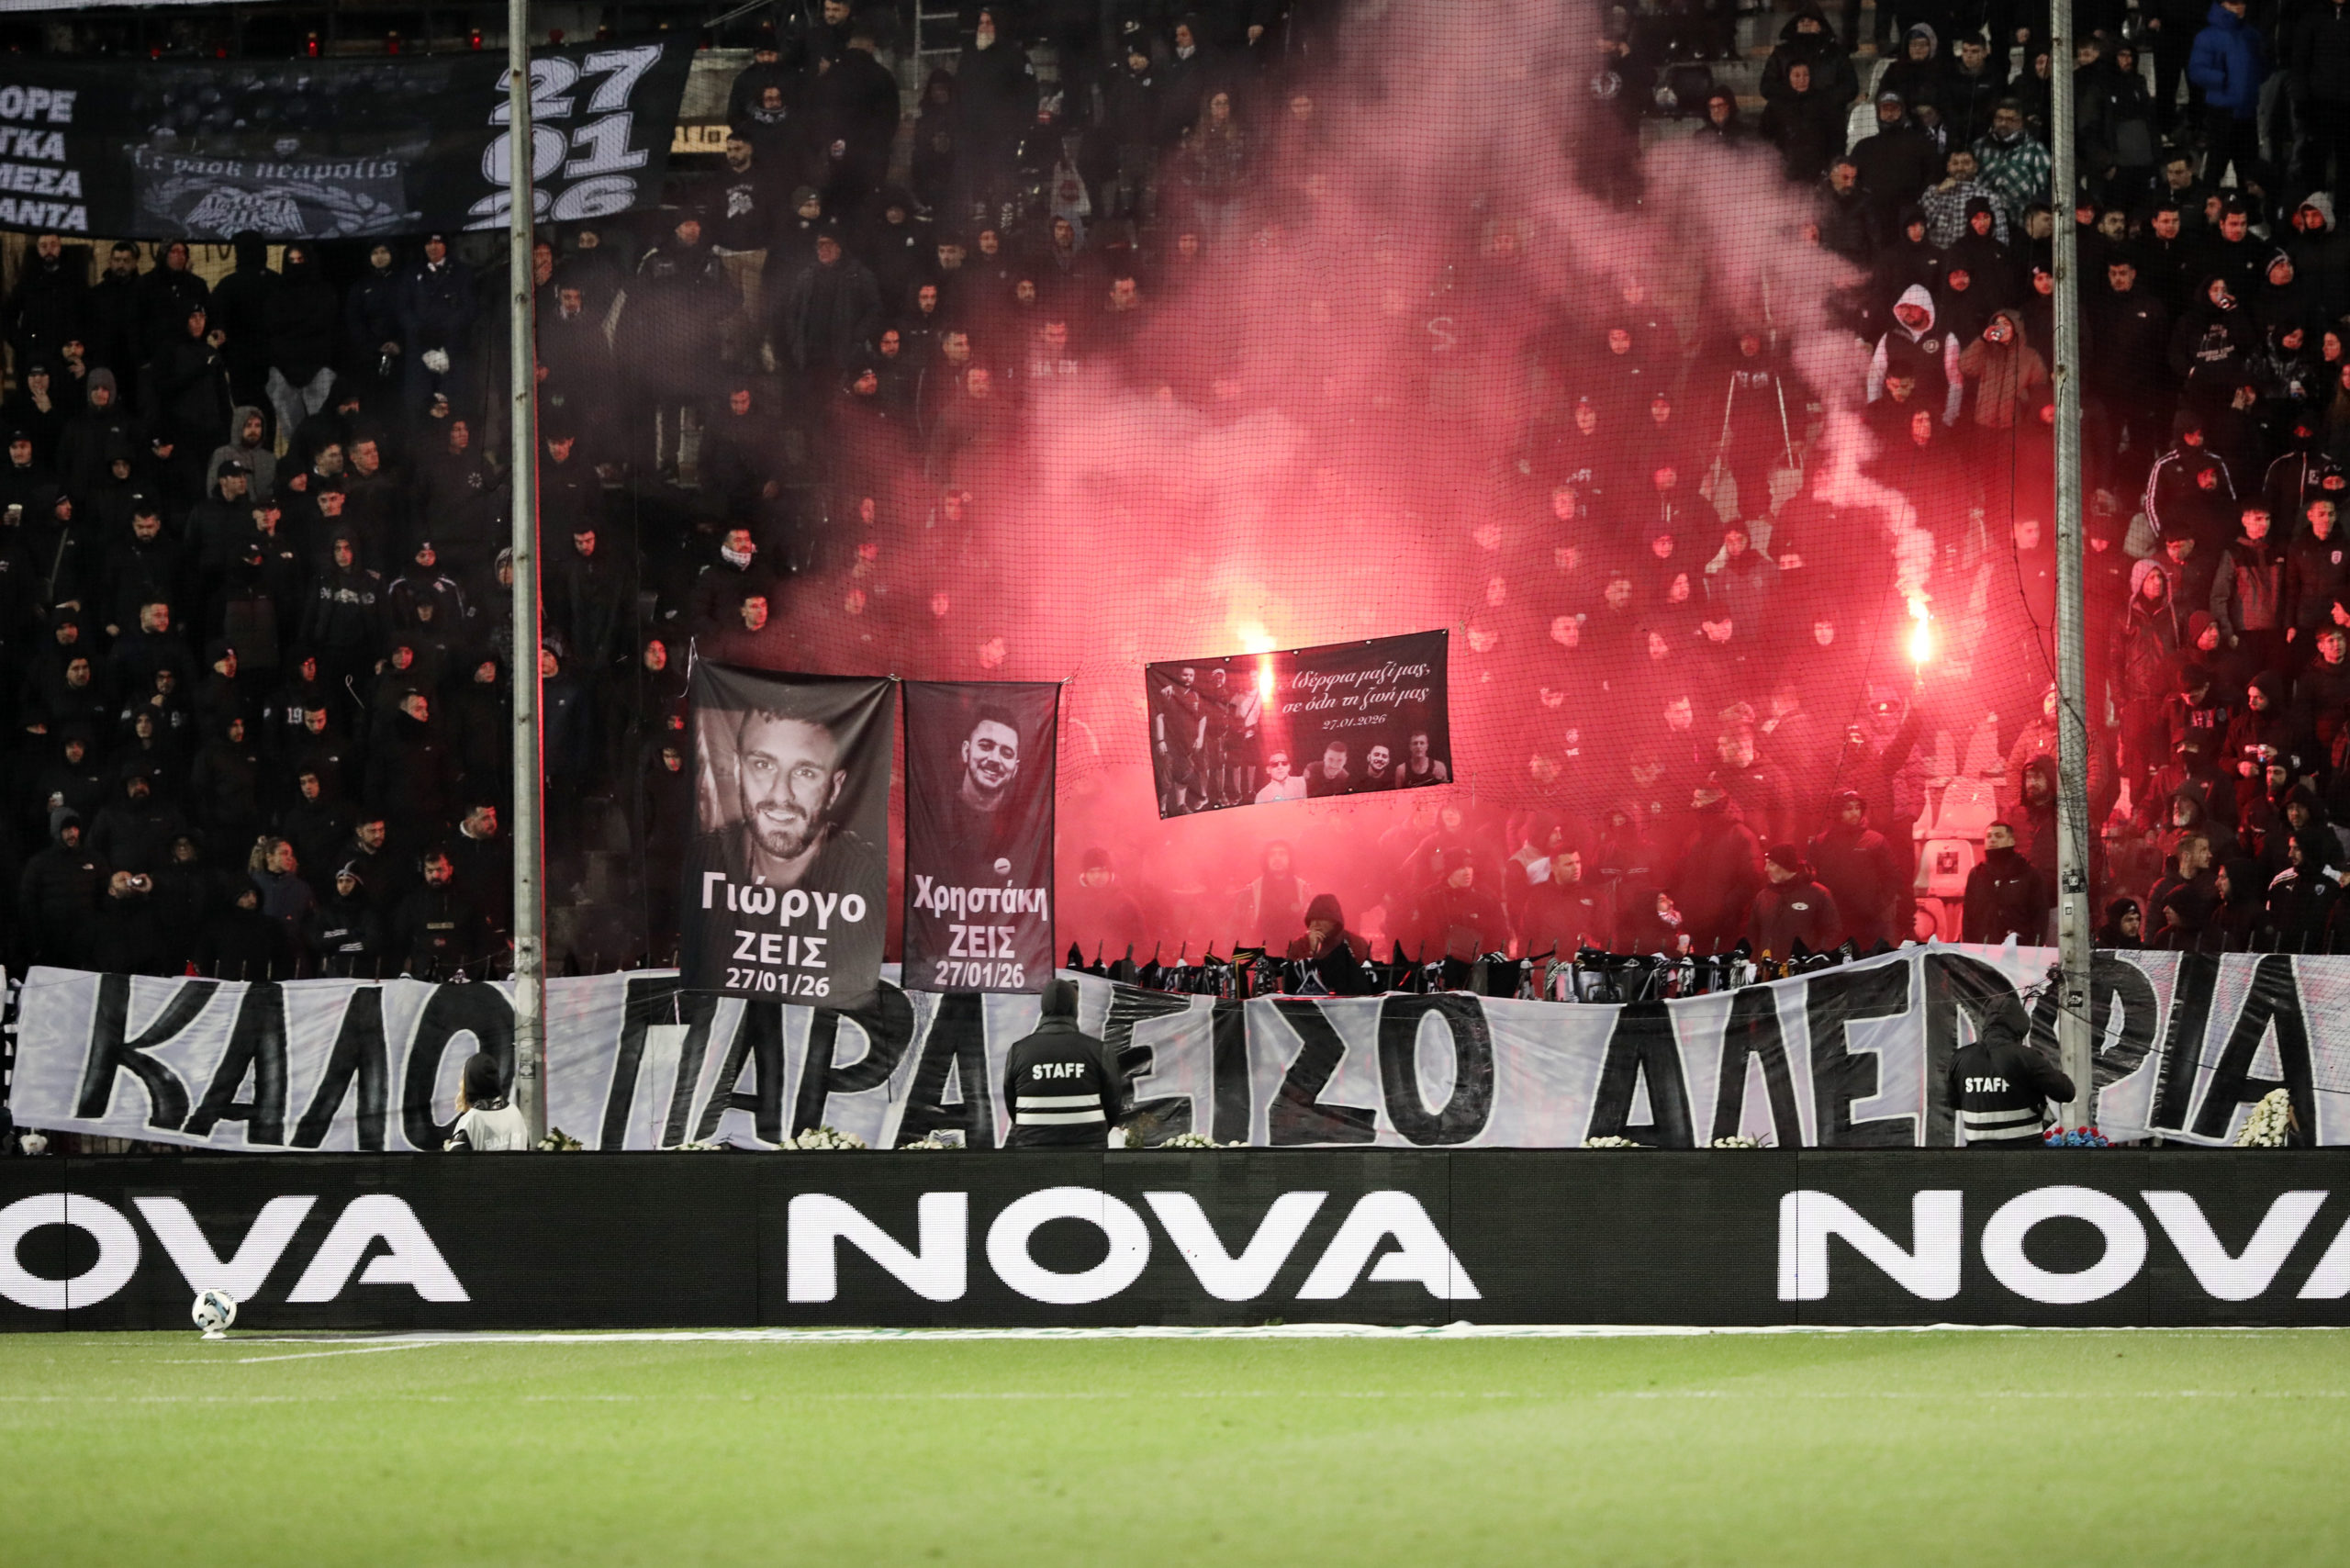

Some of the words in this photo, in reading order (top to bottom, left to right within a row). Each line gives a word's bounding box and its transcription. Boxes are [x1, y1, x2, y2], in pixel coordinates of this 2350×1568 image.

[487, 43, 664, 125] 27
[481, 111, 650, 186] 01
[462, 174, 638, 231] 26
[1282, 701, 1303, 713] σε
[1305, 692, 1336, 711] όλη
[1342, 695, 1360, 708] τη
[1359, 687, 1396, 711] ζωή
[1394, 688, 1430, 708] μας
[1322, 713, 1388, 730] 27.01.2026
[701, 871, 867, 930] Γιώργο
[913, 874, 1048, 922] Χρηστάκη
[733, 929, 828, 969] ΖΕΙΣ
[948, 924, 1015, 958] ΖΕΙΣ
[725, 967, 830, 998] 27/01/26
[934, 960, 1025, 989] 27/01/26
[599, 977, 1494, 1151] ΠΑΡΑΕΙΣΟ
[1032, 1063, 1085, 1081] STAFF
[0, 1193, 471, 1310] OVA
[788, 1186, 1483, 1304] NOVA
